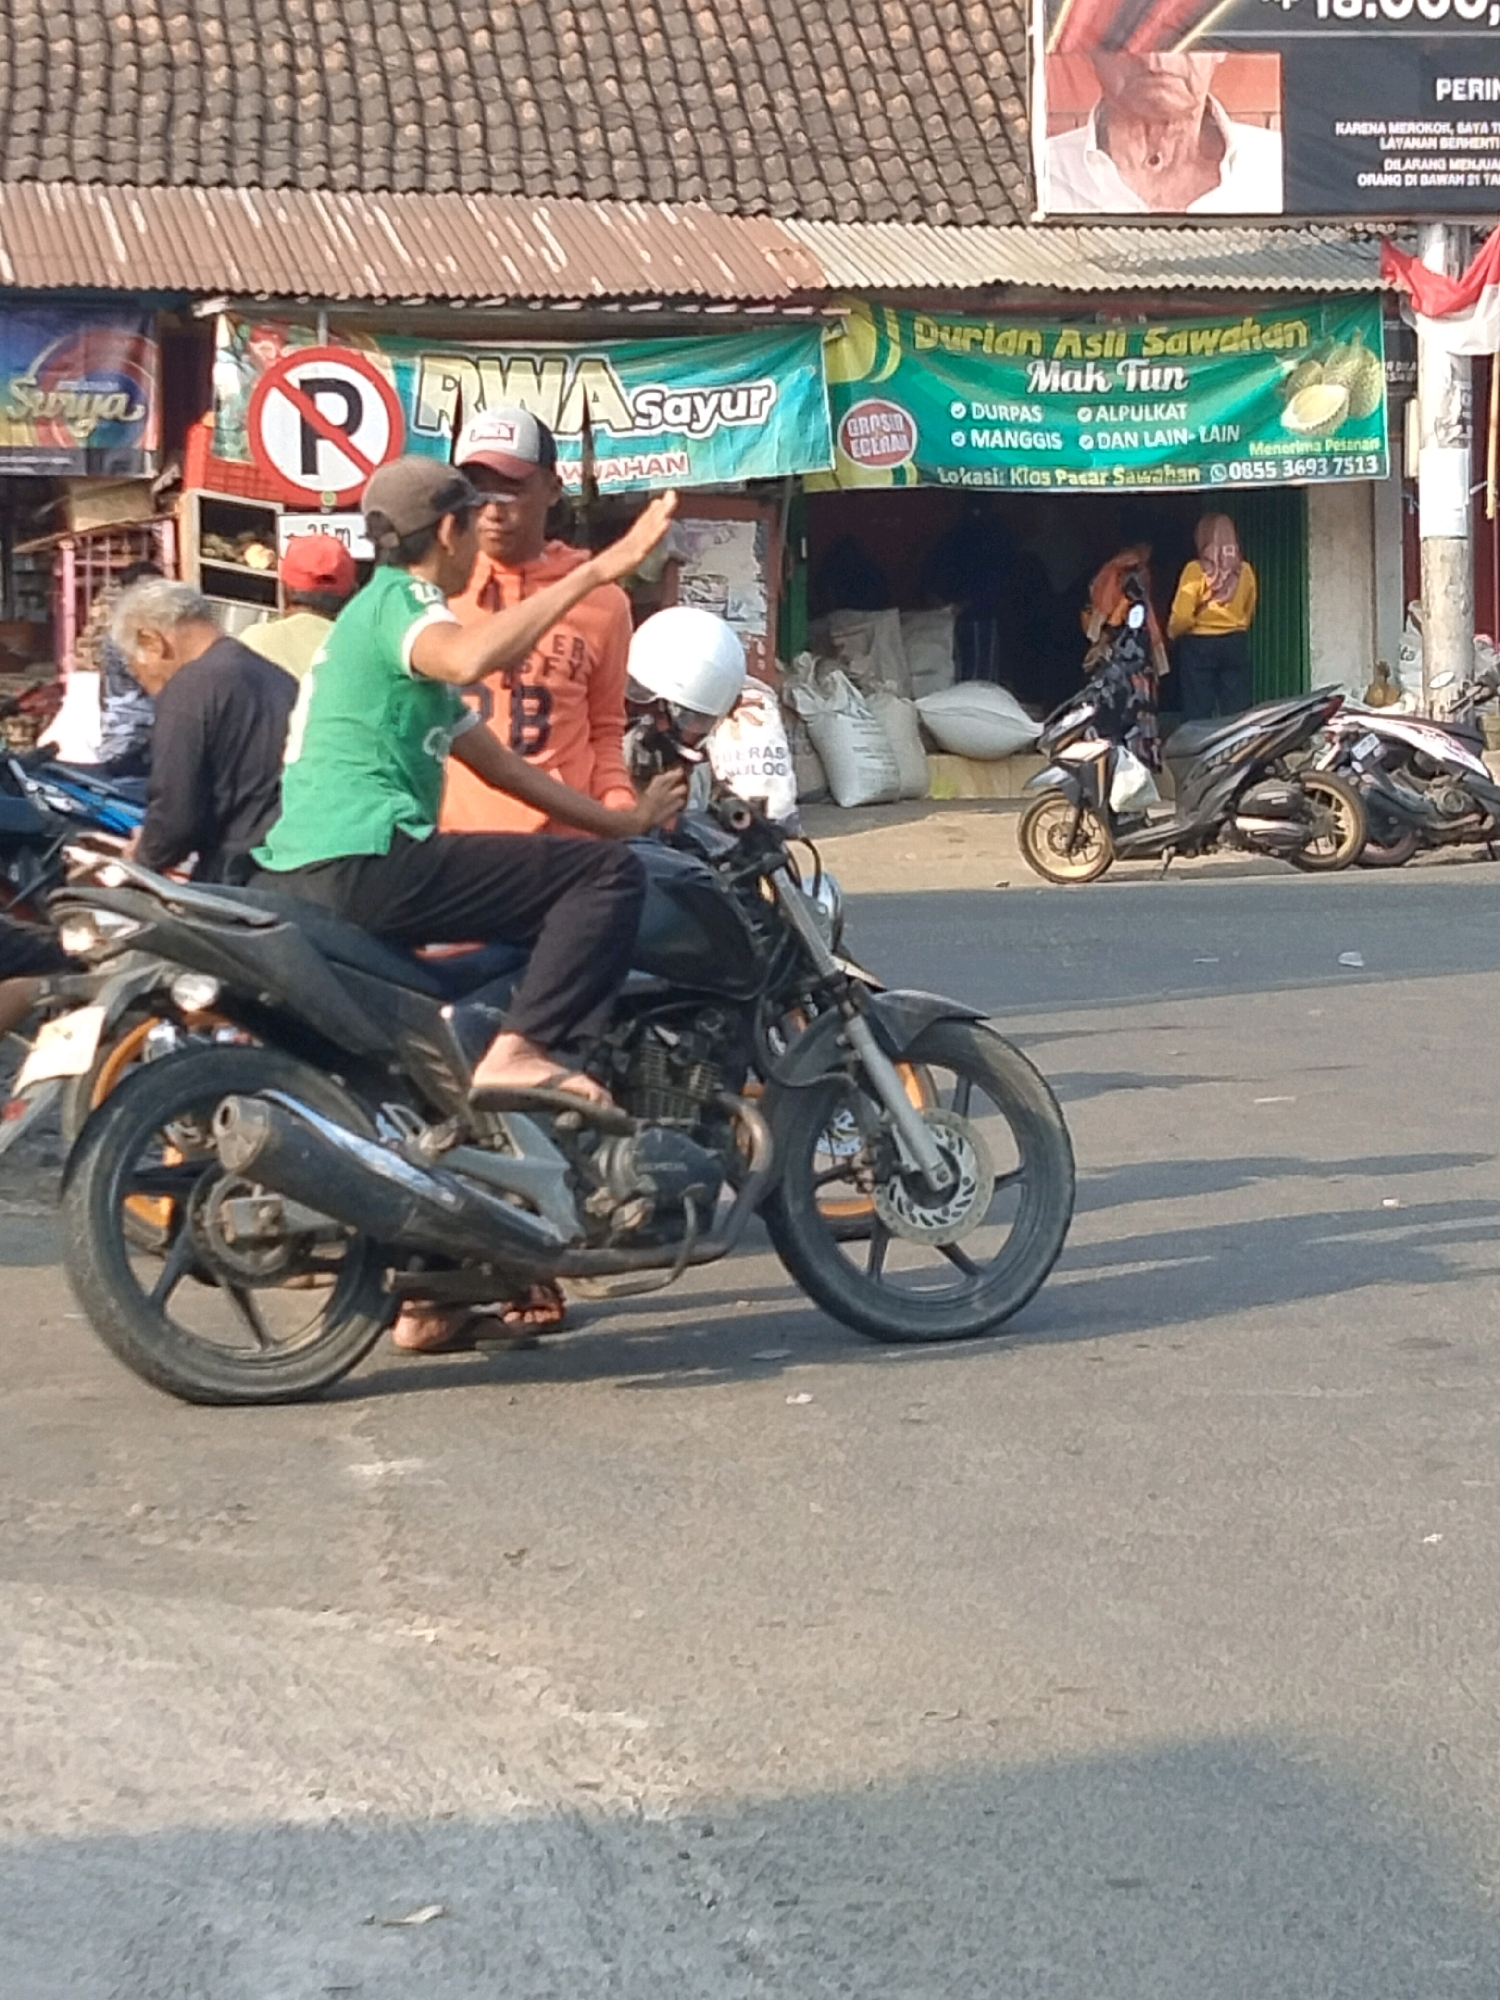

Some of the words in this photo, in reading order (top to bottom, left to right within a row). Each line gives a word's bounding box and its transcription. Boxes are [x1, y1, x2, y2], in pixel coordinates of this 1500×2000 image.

[914, 316, 1042, 356] Durian
[1142, 317, 1308, 357] Sawahan
[1026, 358, 1112, 393] Mak
[1116, 357, 1190, 393] Tun
[971, 402, 1043, 422] DURPAS
[1095, 403, 1188, 422] ALPULKAT
[298, 378, 363, 476] P
[970, 428, 1063, 449] MANGGIS
[1097, 431, 1139, 450] DAN
[1249, 439, 1322, 456] Menerima
[562, 454, 686, 482] WAHAN
[1112, 463, 1201, 486] Sawahan
[1229, 461, 1277, 480] 0855
[1282, 458, 1328, 477] 3693
[1332, 455, 1379, 475] 7513
[552, 633, 586, 661] ER
